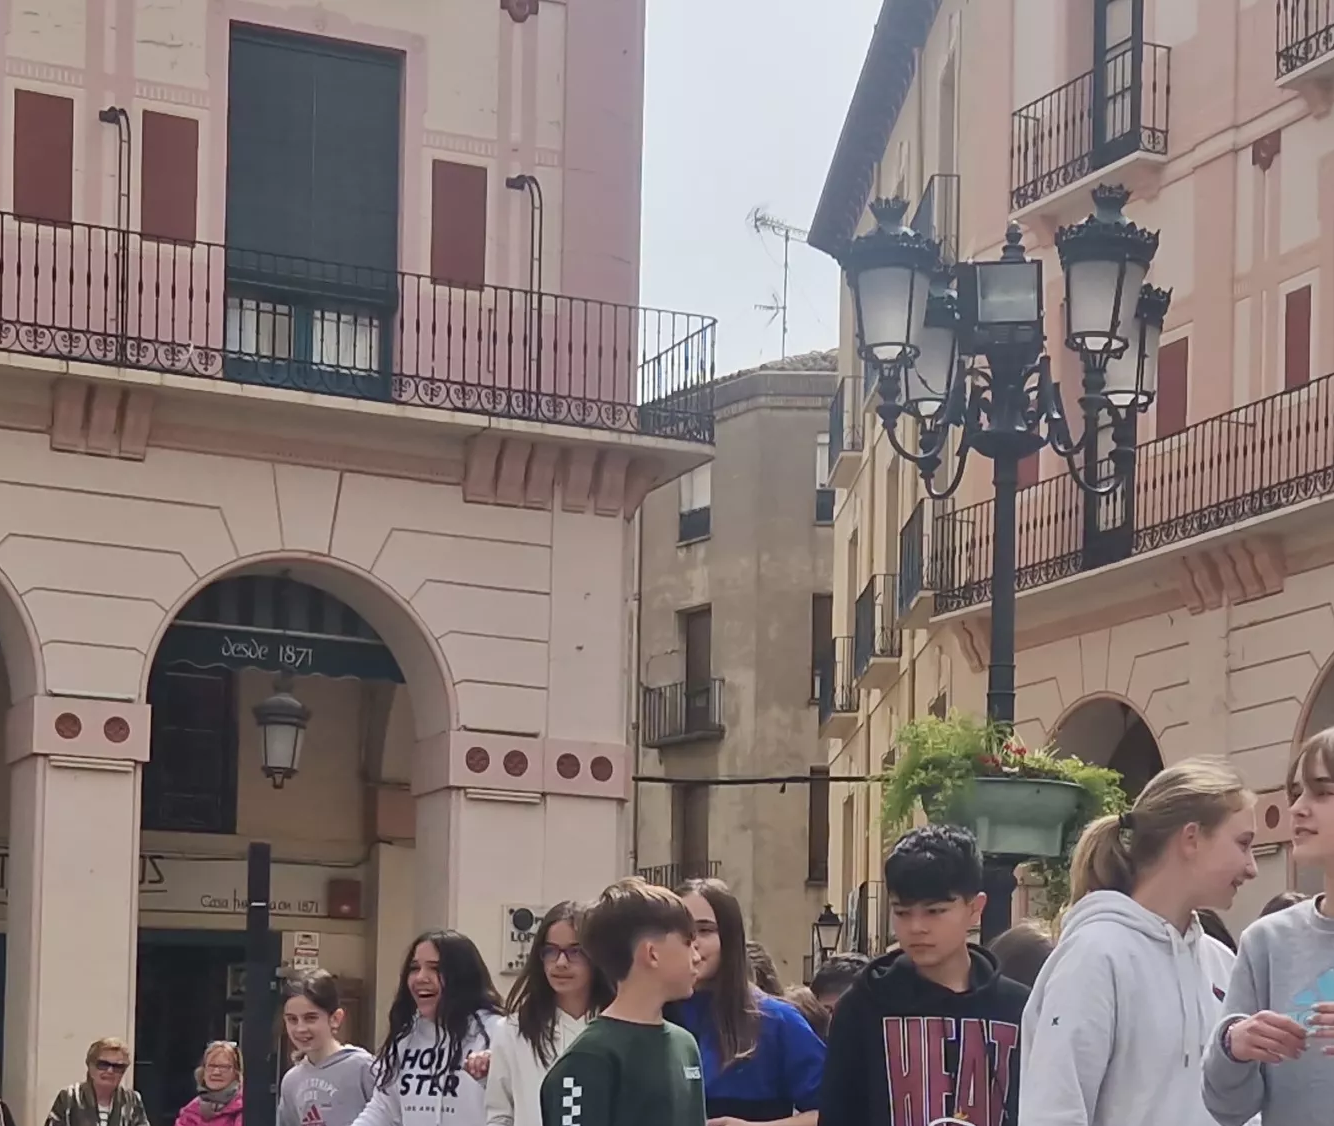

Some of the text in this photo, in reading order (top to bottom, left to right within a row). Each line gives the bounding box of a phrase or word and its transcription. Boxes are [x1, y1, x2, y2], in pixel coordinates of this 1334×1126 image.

[221, 635, 313, 668] desde 1871
[298, 901, 319, 914] 1871
[399, 1073, 459, 1098] STER
